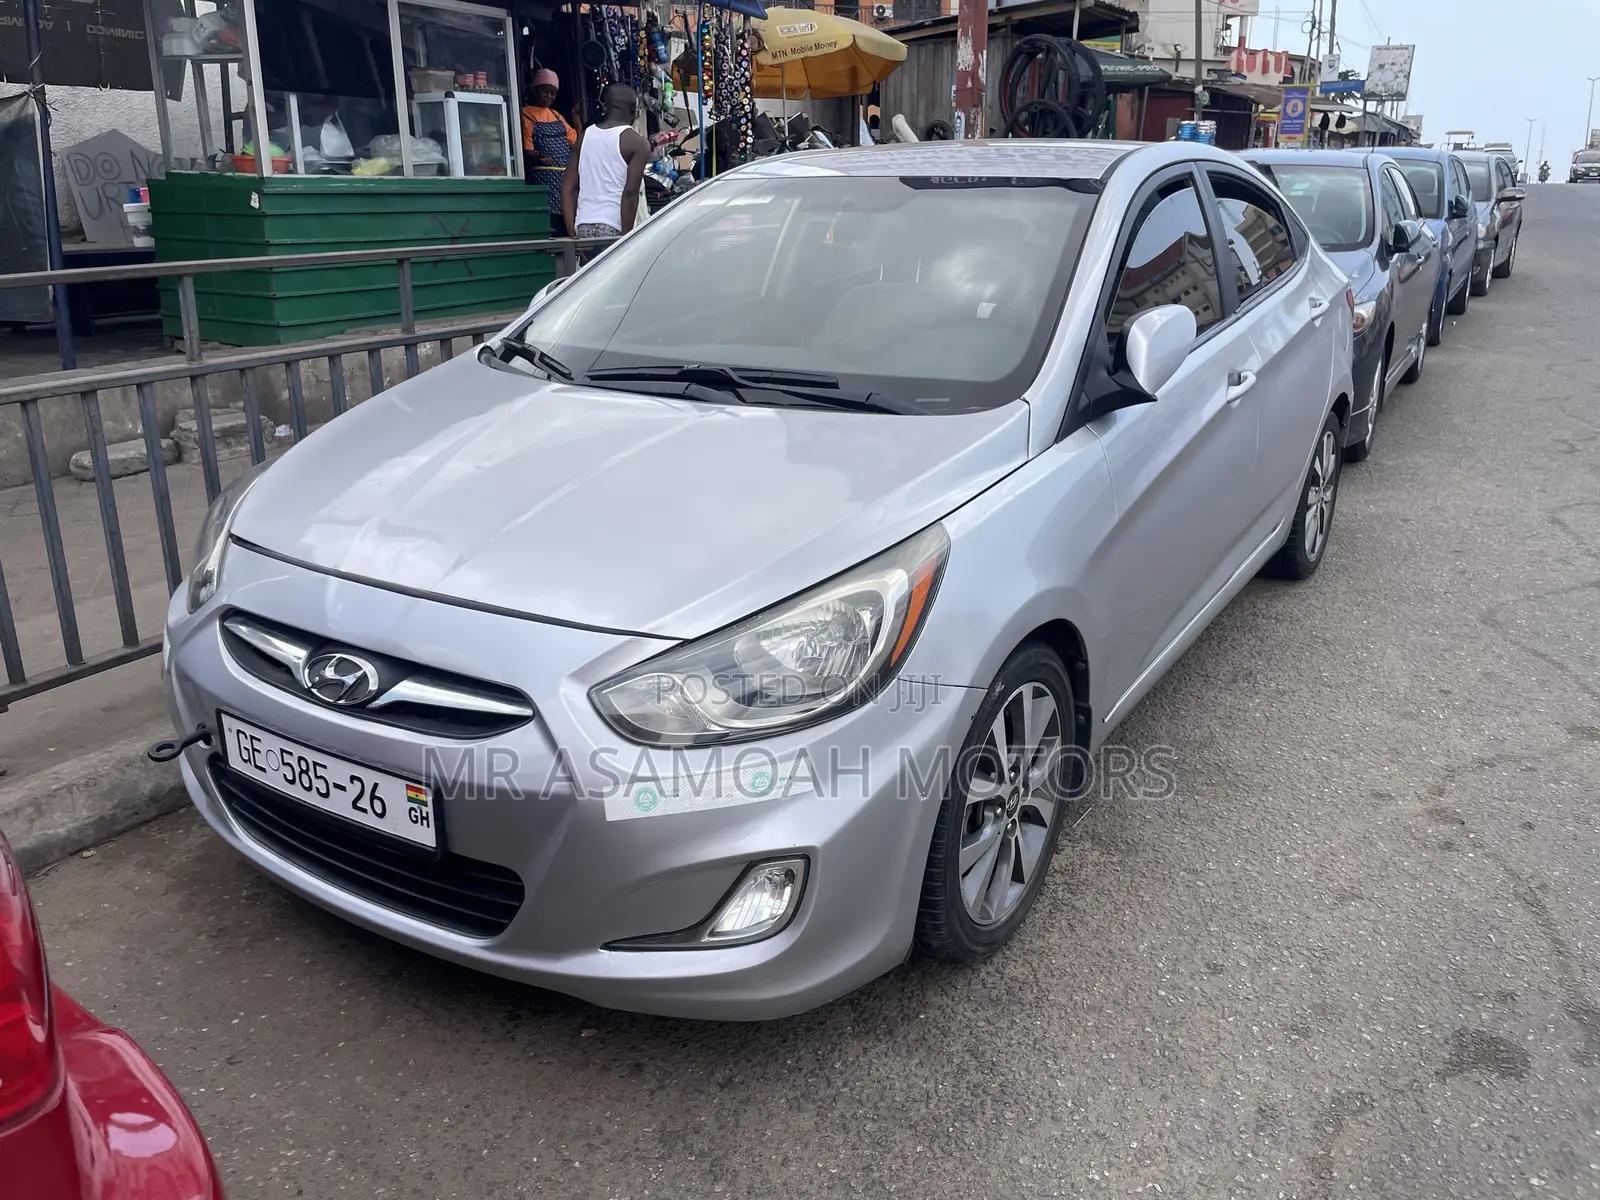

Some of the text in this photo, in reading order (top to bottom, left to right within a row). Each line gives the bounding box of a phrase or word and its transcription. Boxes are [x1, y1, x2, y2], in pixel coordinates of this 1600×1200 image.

[771, 40, 838, 60] MTN Mobile Money
[66, 151, 121, 187] DO
[236, 728, 387, 819] GE 585-26
[408, 806, 431, 829] GH
